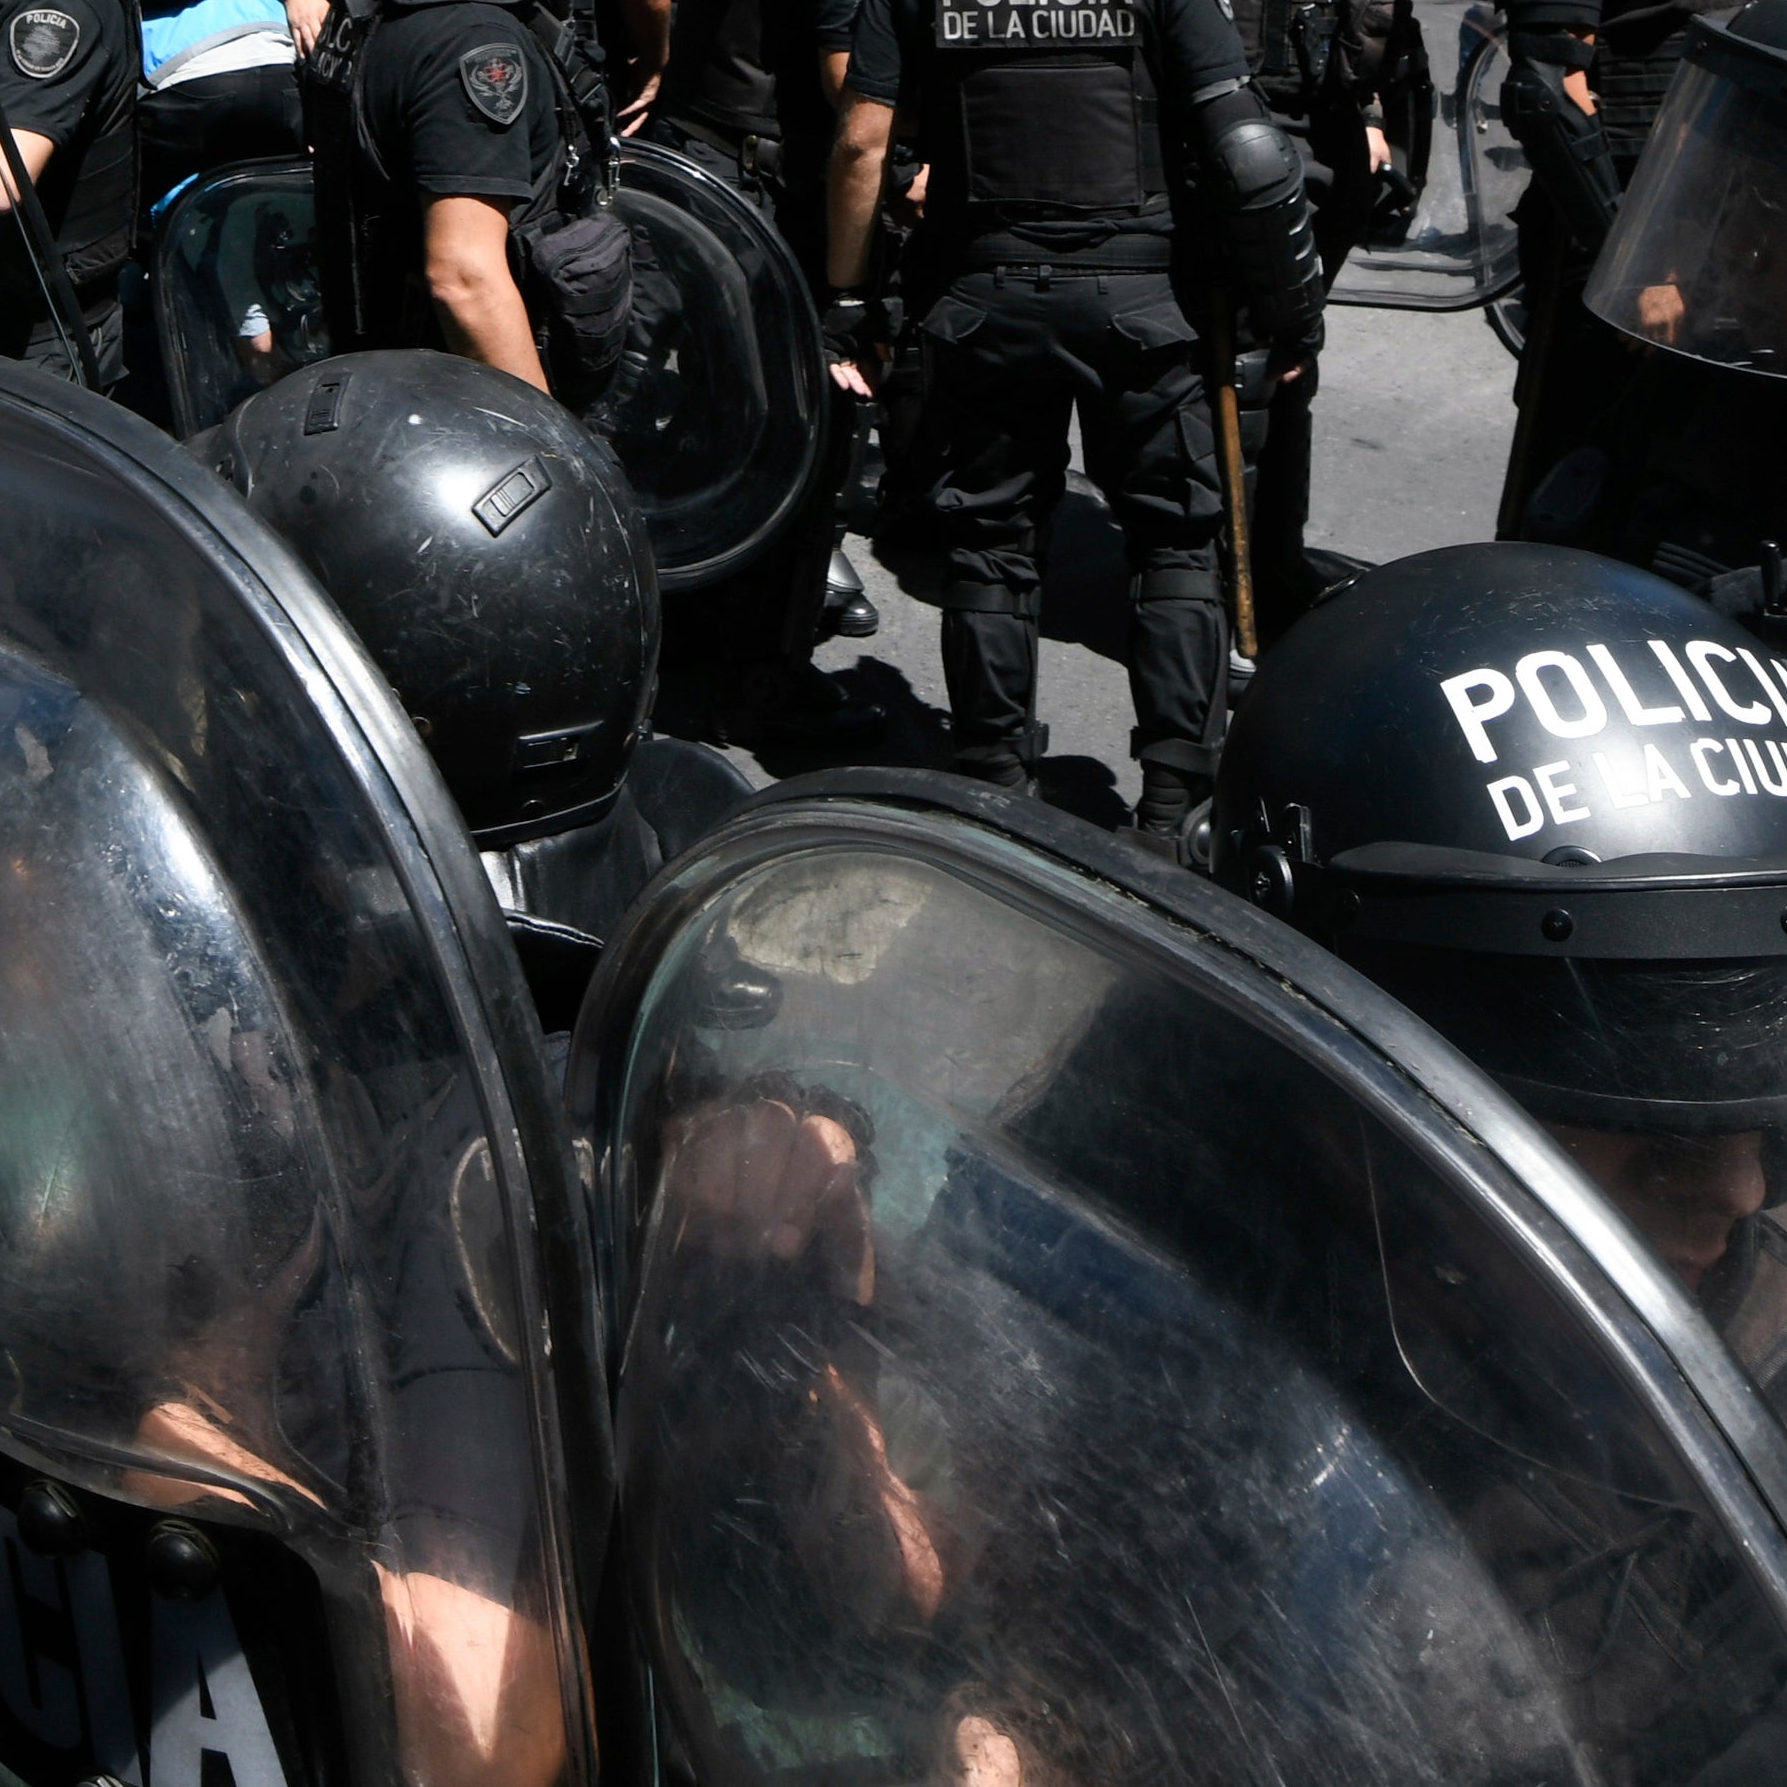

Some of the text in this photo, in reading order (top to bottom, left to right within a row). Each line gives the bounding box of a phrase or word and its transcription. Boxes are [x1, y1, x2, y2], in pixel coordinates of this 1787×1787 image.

[25, 13, 67, 30] POLICIA
[943, 11, 1136, 41] DE LA CIUDAD
[1487, 766, 1593, 842] DE
[1597, 746, 1687, 815] LA
